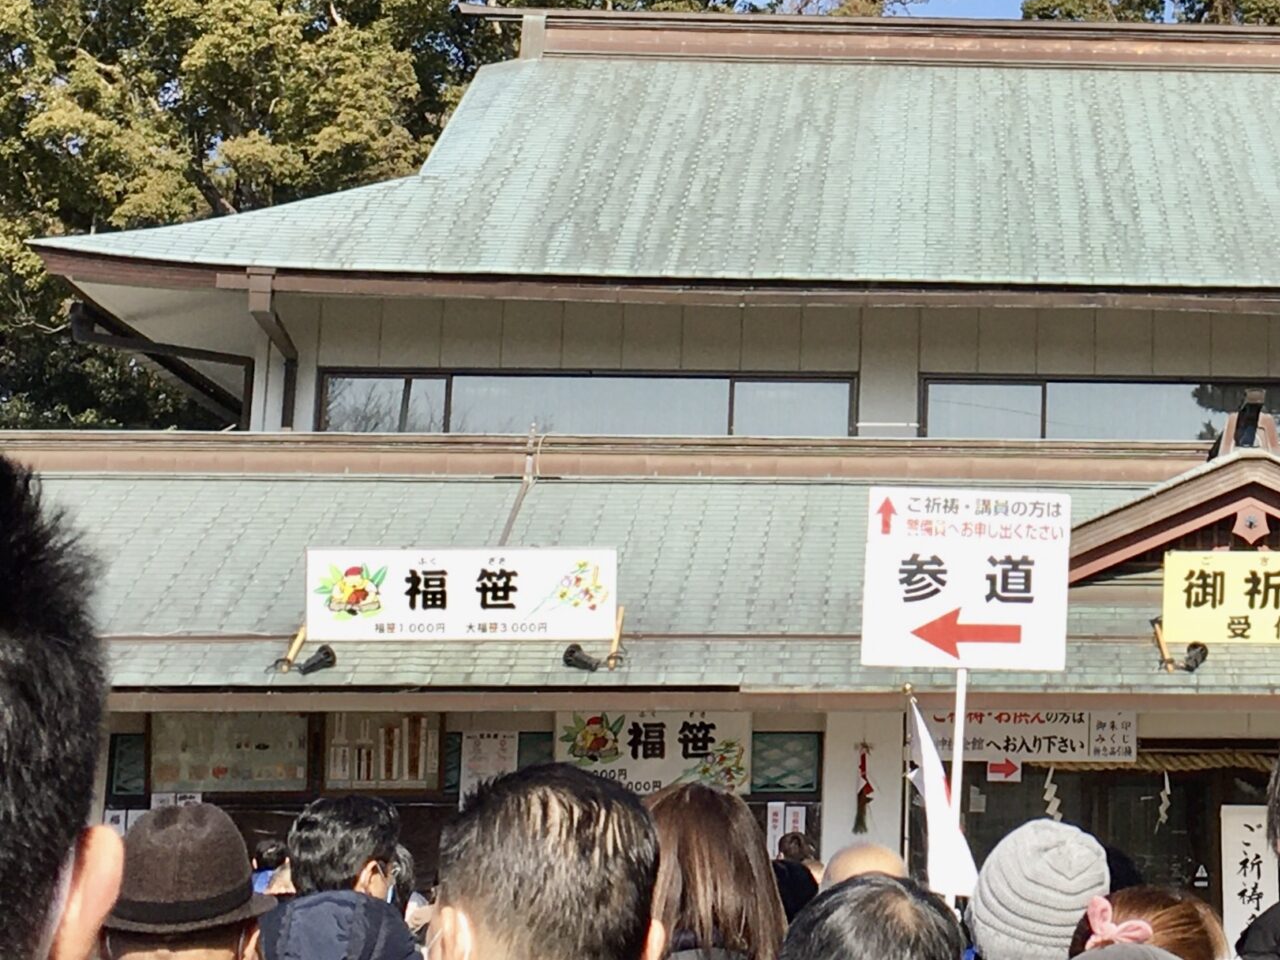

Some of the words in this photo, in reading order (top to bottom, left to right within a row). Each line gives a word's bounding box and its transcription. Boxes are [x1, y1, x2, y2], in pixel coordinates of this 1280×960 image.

[404, 568, 519, 611] 福笹
[898, 553, 1035, 604] 参道
[627, 721, 717, 760] 福笹
